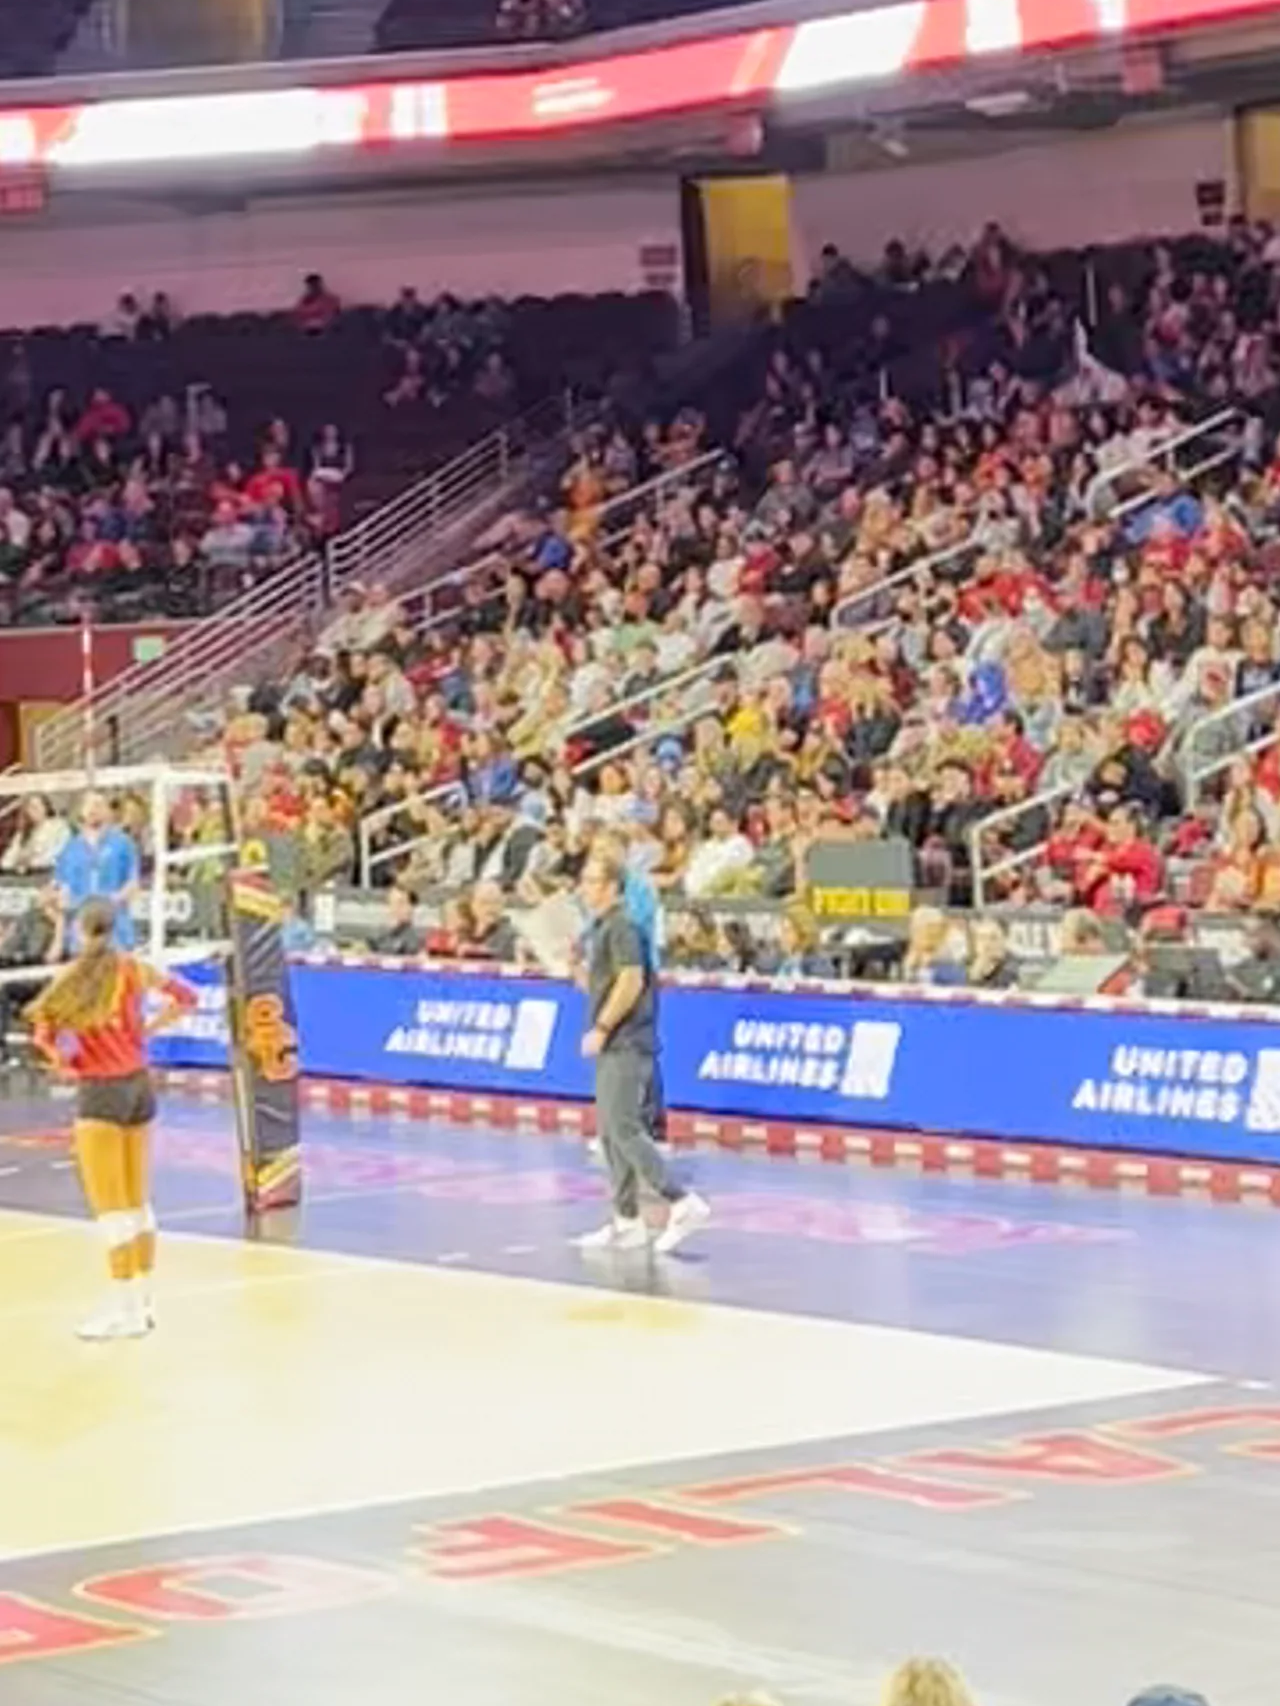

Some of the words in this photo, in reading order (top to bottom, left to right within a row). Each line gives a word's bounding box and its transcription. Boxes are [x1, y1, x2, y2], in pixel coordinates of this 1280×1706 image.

[416, 999, 512, 1032] UNITED
[385, 1027, 506, 1063] AIRLINES
[733, 1018, 845, 1054] UNITED
[698, 1048, 840, 1091] AIRLINES
[1111, 1044, 1248, 1085] UNITED
[1072, 1078, 1241, 1123] AIRLINES
